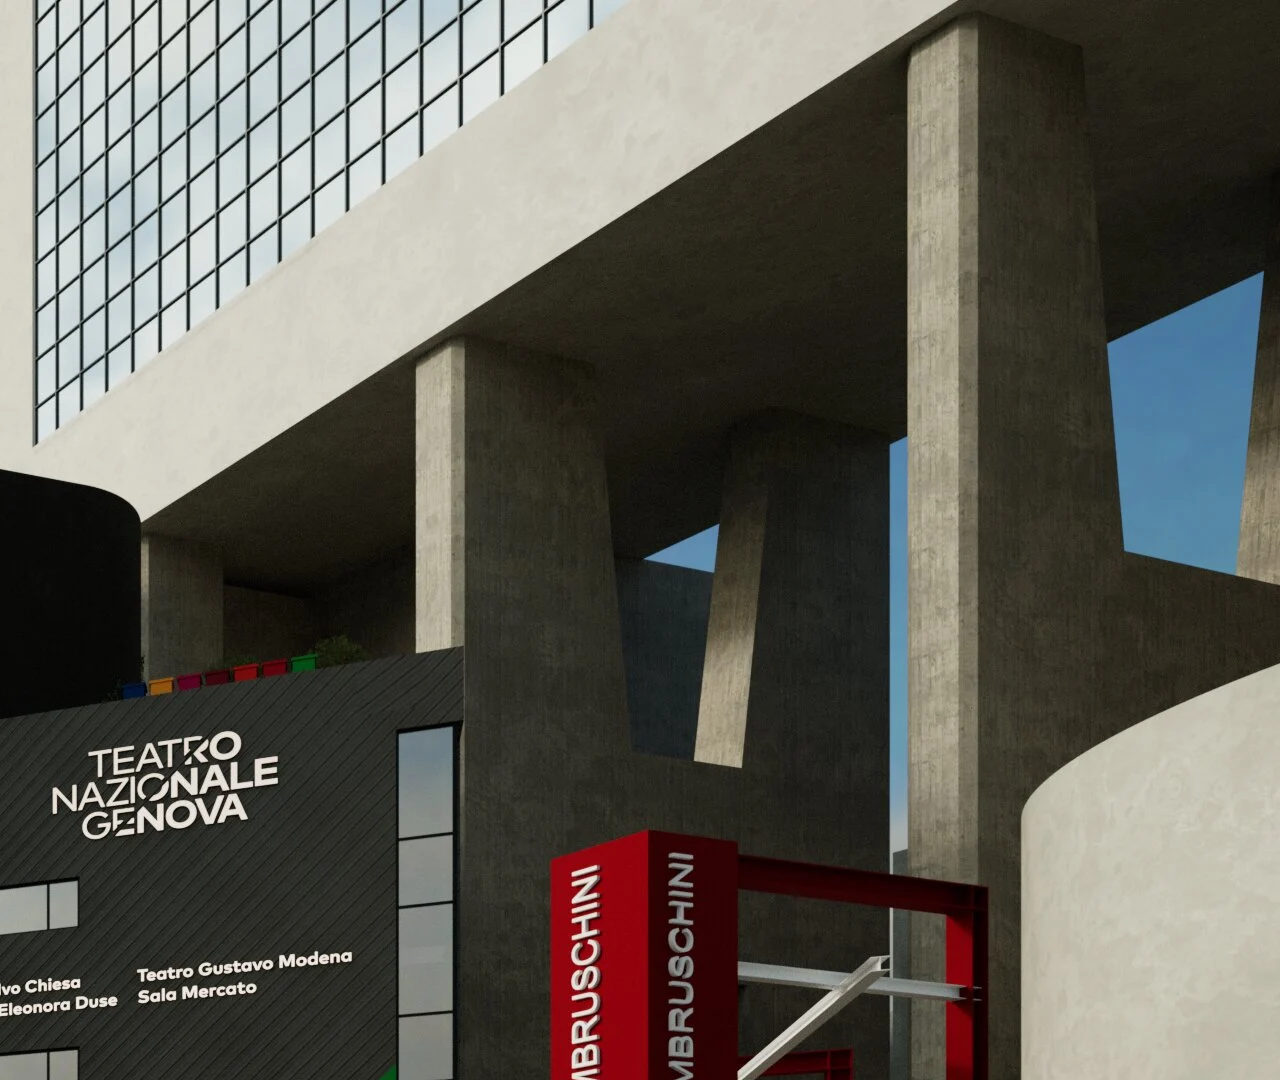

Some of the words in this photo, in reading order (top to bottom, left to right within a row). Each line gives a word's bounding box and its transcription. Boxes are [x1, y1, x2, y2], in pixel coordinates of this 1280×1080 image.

[88, 731, 241, 778] TEATRO
[52, 756, 279, 814] NAZIONALE
[82, 793, 248, 840] GENOVA
[137, 966, 194, 982] Teatro
[198, 959, 274, 977] Gustavo
[278, 951, 353, 968] Modena
[25, 977, 81, 993] Chiesa
[137, 988, 177, 1004] Sala
[181, 982, 258, 1000] Mercato
[75, 996, 118, 1010] Duse
